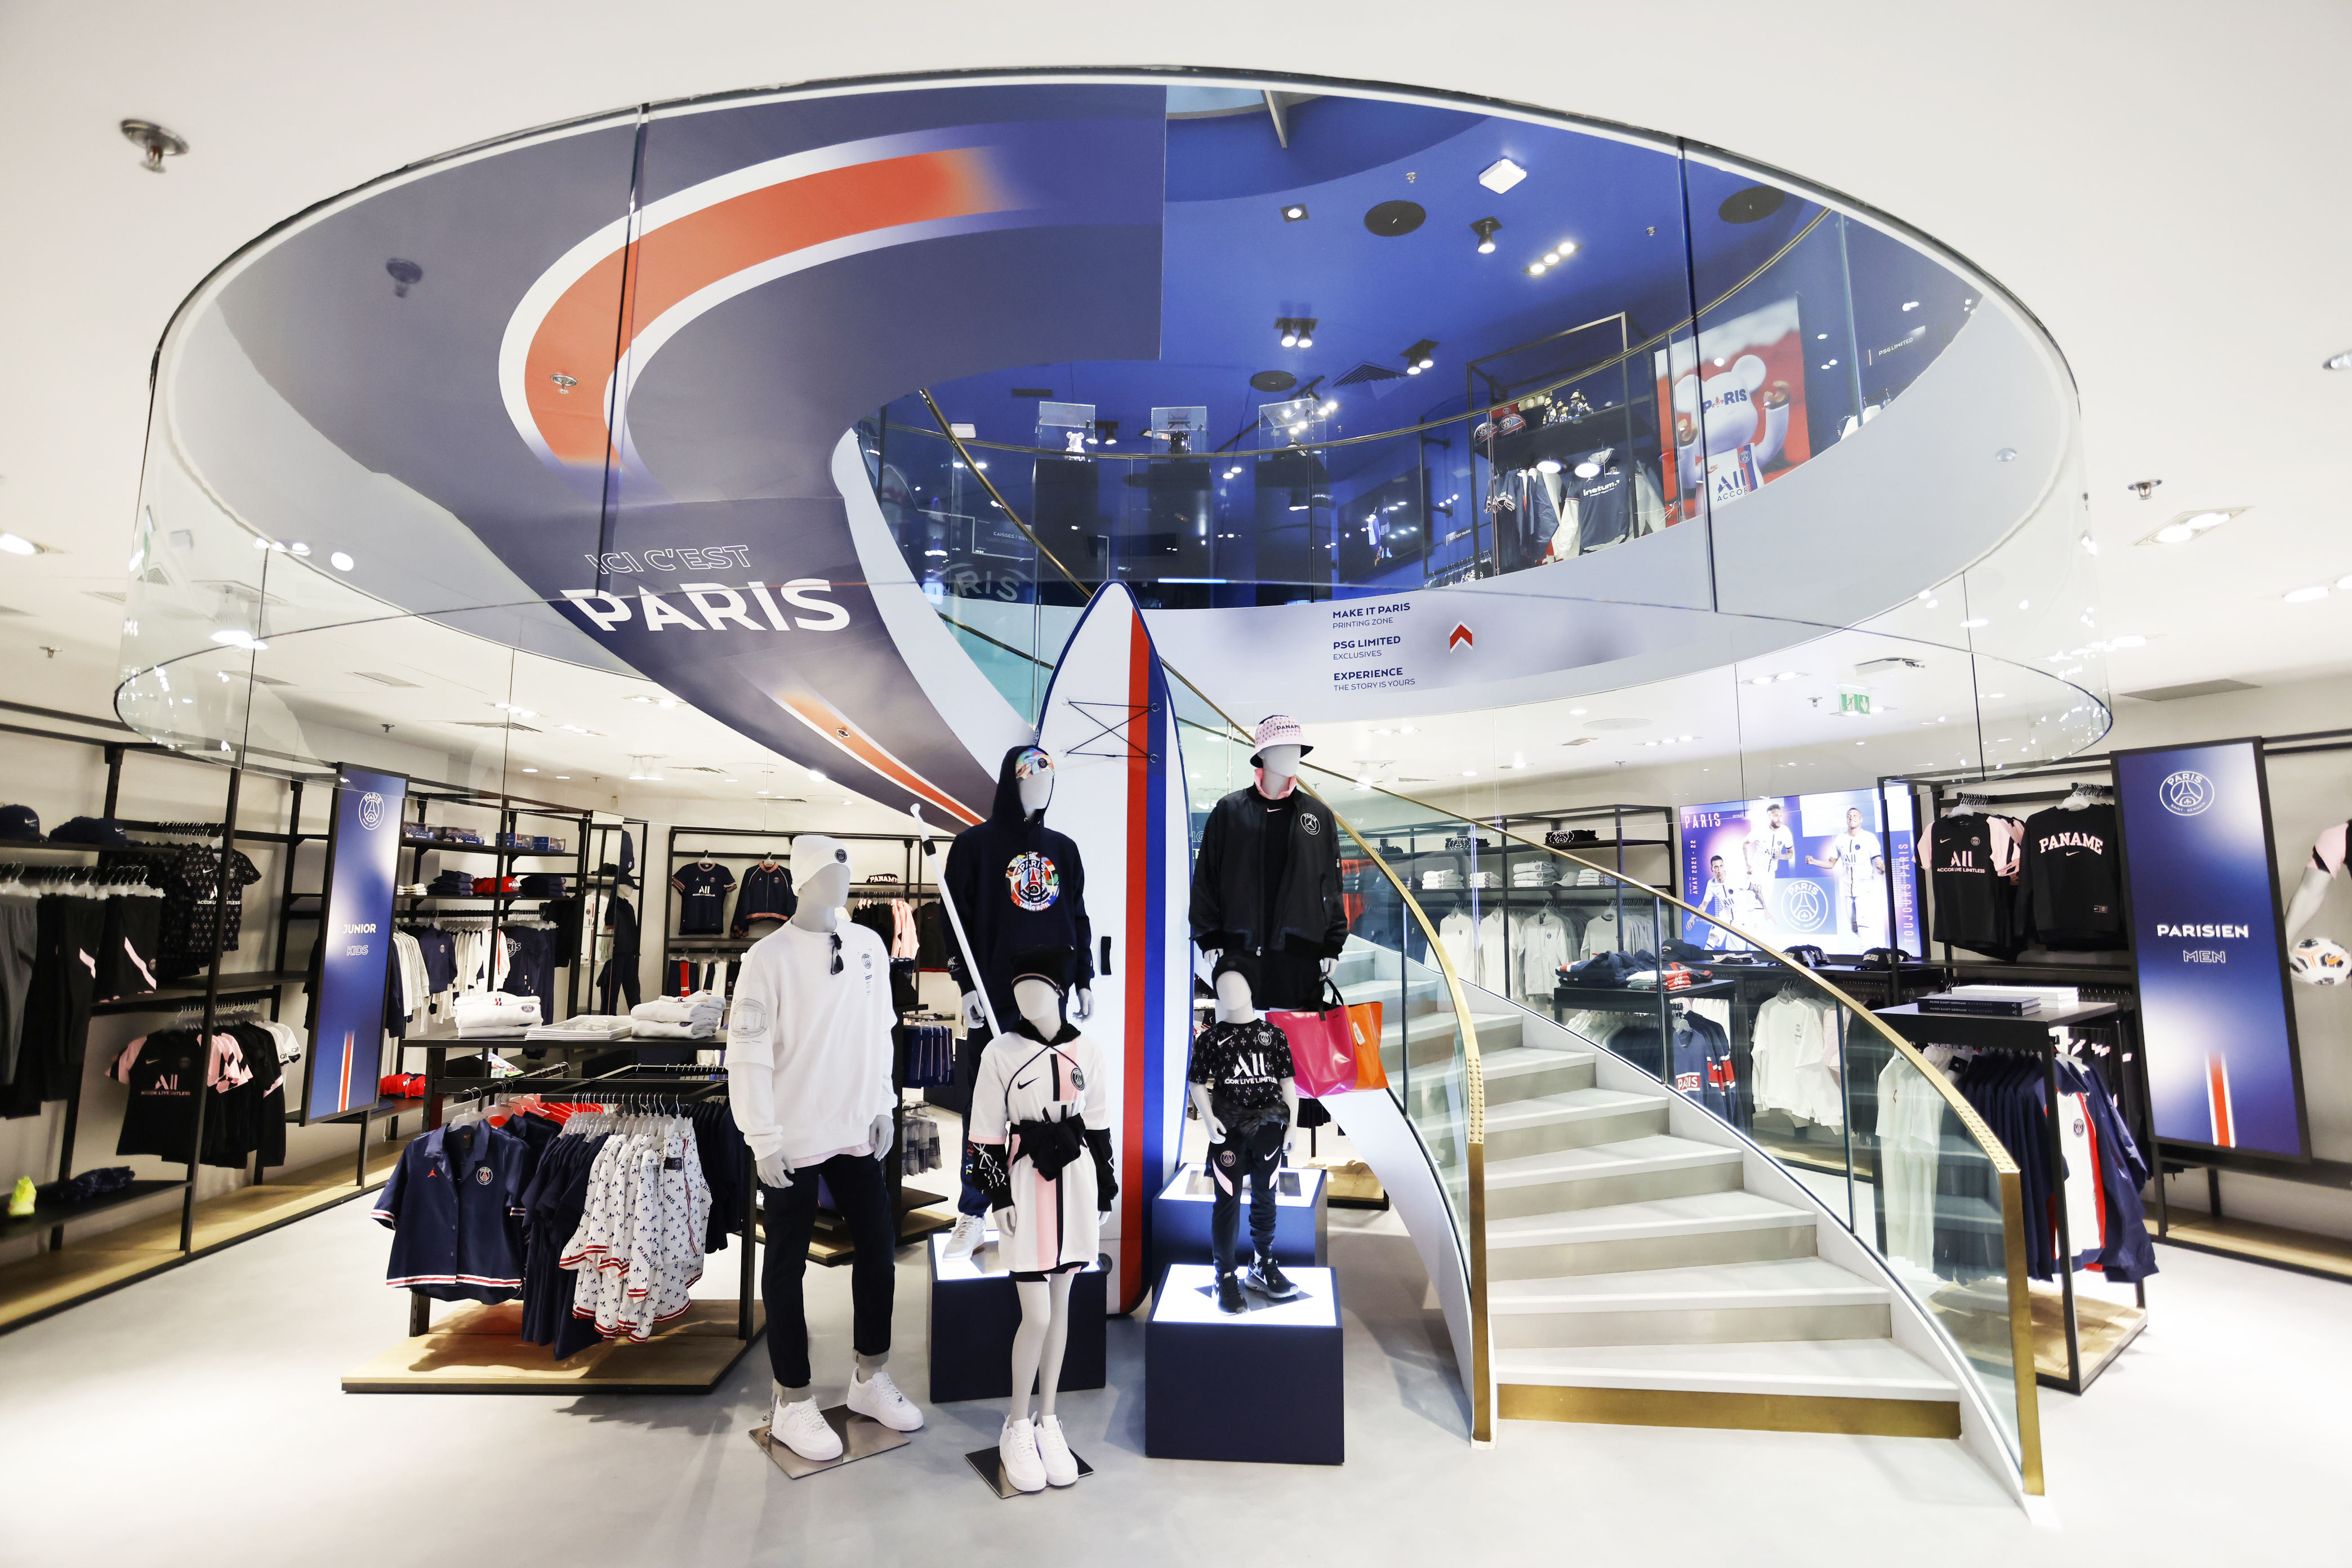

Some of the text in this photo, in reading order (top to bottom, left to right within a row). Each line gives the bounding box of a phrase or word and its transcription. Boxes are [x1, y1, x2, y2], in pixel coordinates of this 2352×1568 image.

[1878, 337, 1913, 356] PSG LIMITED
[1717, 486, 1748, 502] ACCOR
[584, 544, 751, 574] ICI C'EST
[559, 577, 851, 632] PARIS
[1333, 603, 1411, 618] MAKE IT PARIS
[1333, 617, 1393, 629] PRINTING ZONE
[1333, 636, 1401, 650] PSG LIMITED
[1333, 650, 1382, 660] EXCLUSIVES
[1334, 667, 1403, 681] EXPERIENCE
[1351, 681, 1378, 691] STORY
[1388, 678, 1415, 687] YOURS
[2167, 773, 2203, 786] PARIS
[364, 794, 381, 804] PARIS
[1685, 812, 1721, 828] PARIS
[1690, 840, 1696, 848] 22
[2039, 832, 2104, 855] PANAME
[1897, 843, 1910, 877] PARIS
[1020, 891, 1048, 901] SAIN GERAIN
[1787, 883, 1819, 896] PARIS
[1900, 883, 1915, 944] TOUJOURS
[342, 923, 377, 934] JUNIOR
[1789, 917, 1820, 928] SAINT GERMAIN
[2157, 924, 2249, 938] PARISIEN
[346, 945, 369, 956] KIDS
[2182, 950, 2226, 963] MEN
